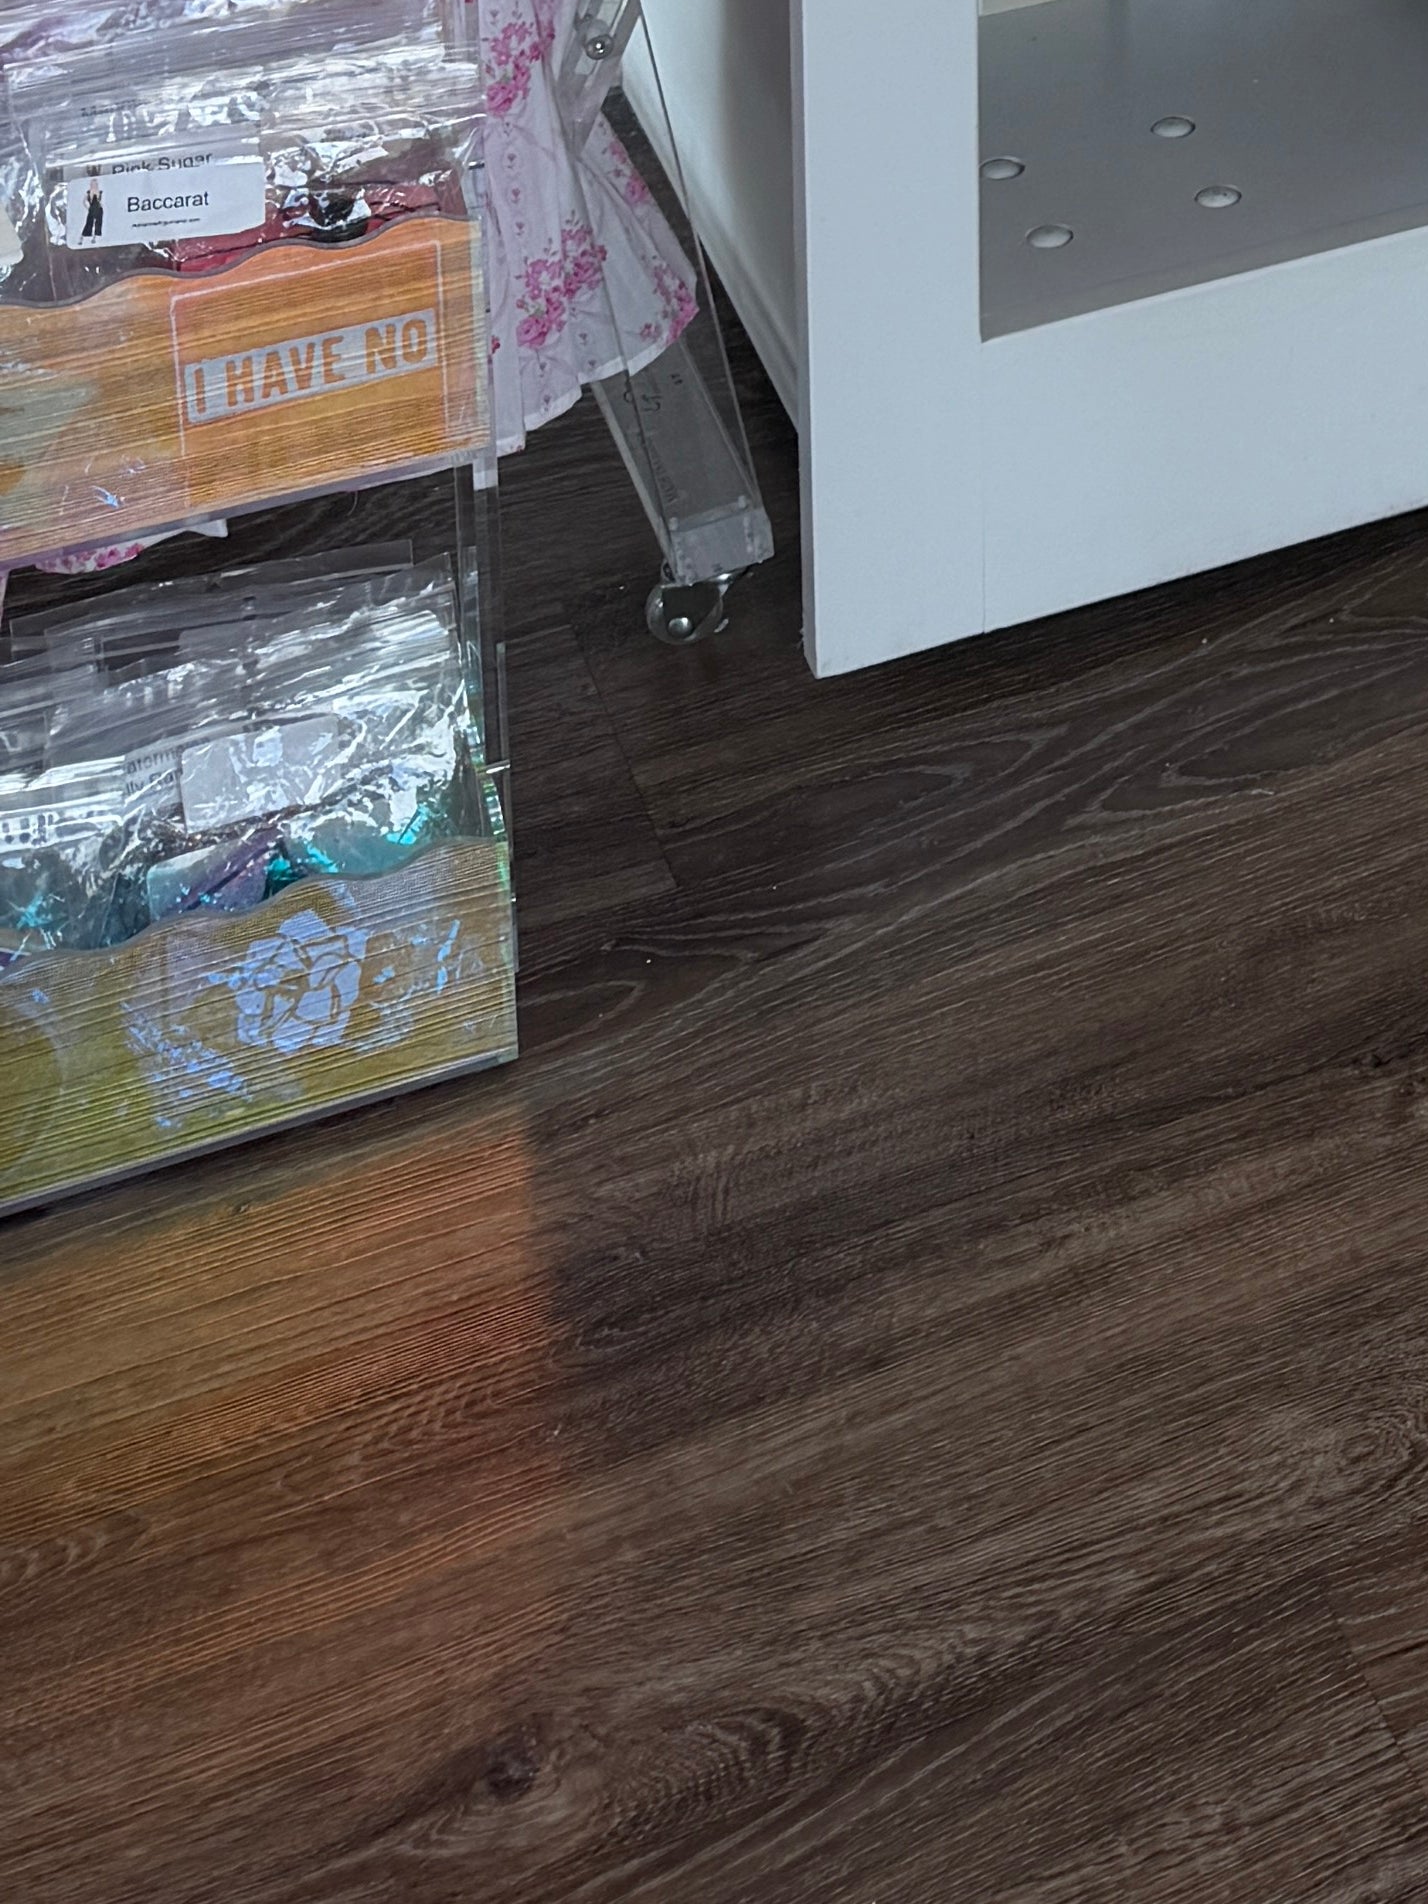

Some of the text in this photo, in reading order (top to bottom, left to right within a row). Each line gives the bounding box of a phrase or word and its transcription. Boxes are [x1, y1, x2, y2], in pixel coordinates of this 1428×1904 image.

[127, 191, 209, 213] Baccarat
[194, 319, 428, 414] I HAVE NO
